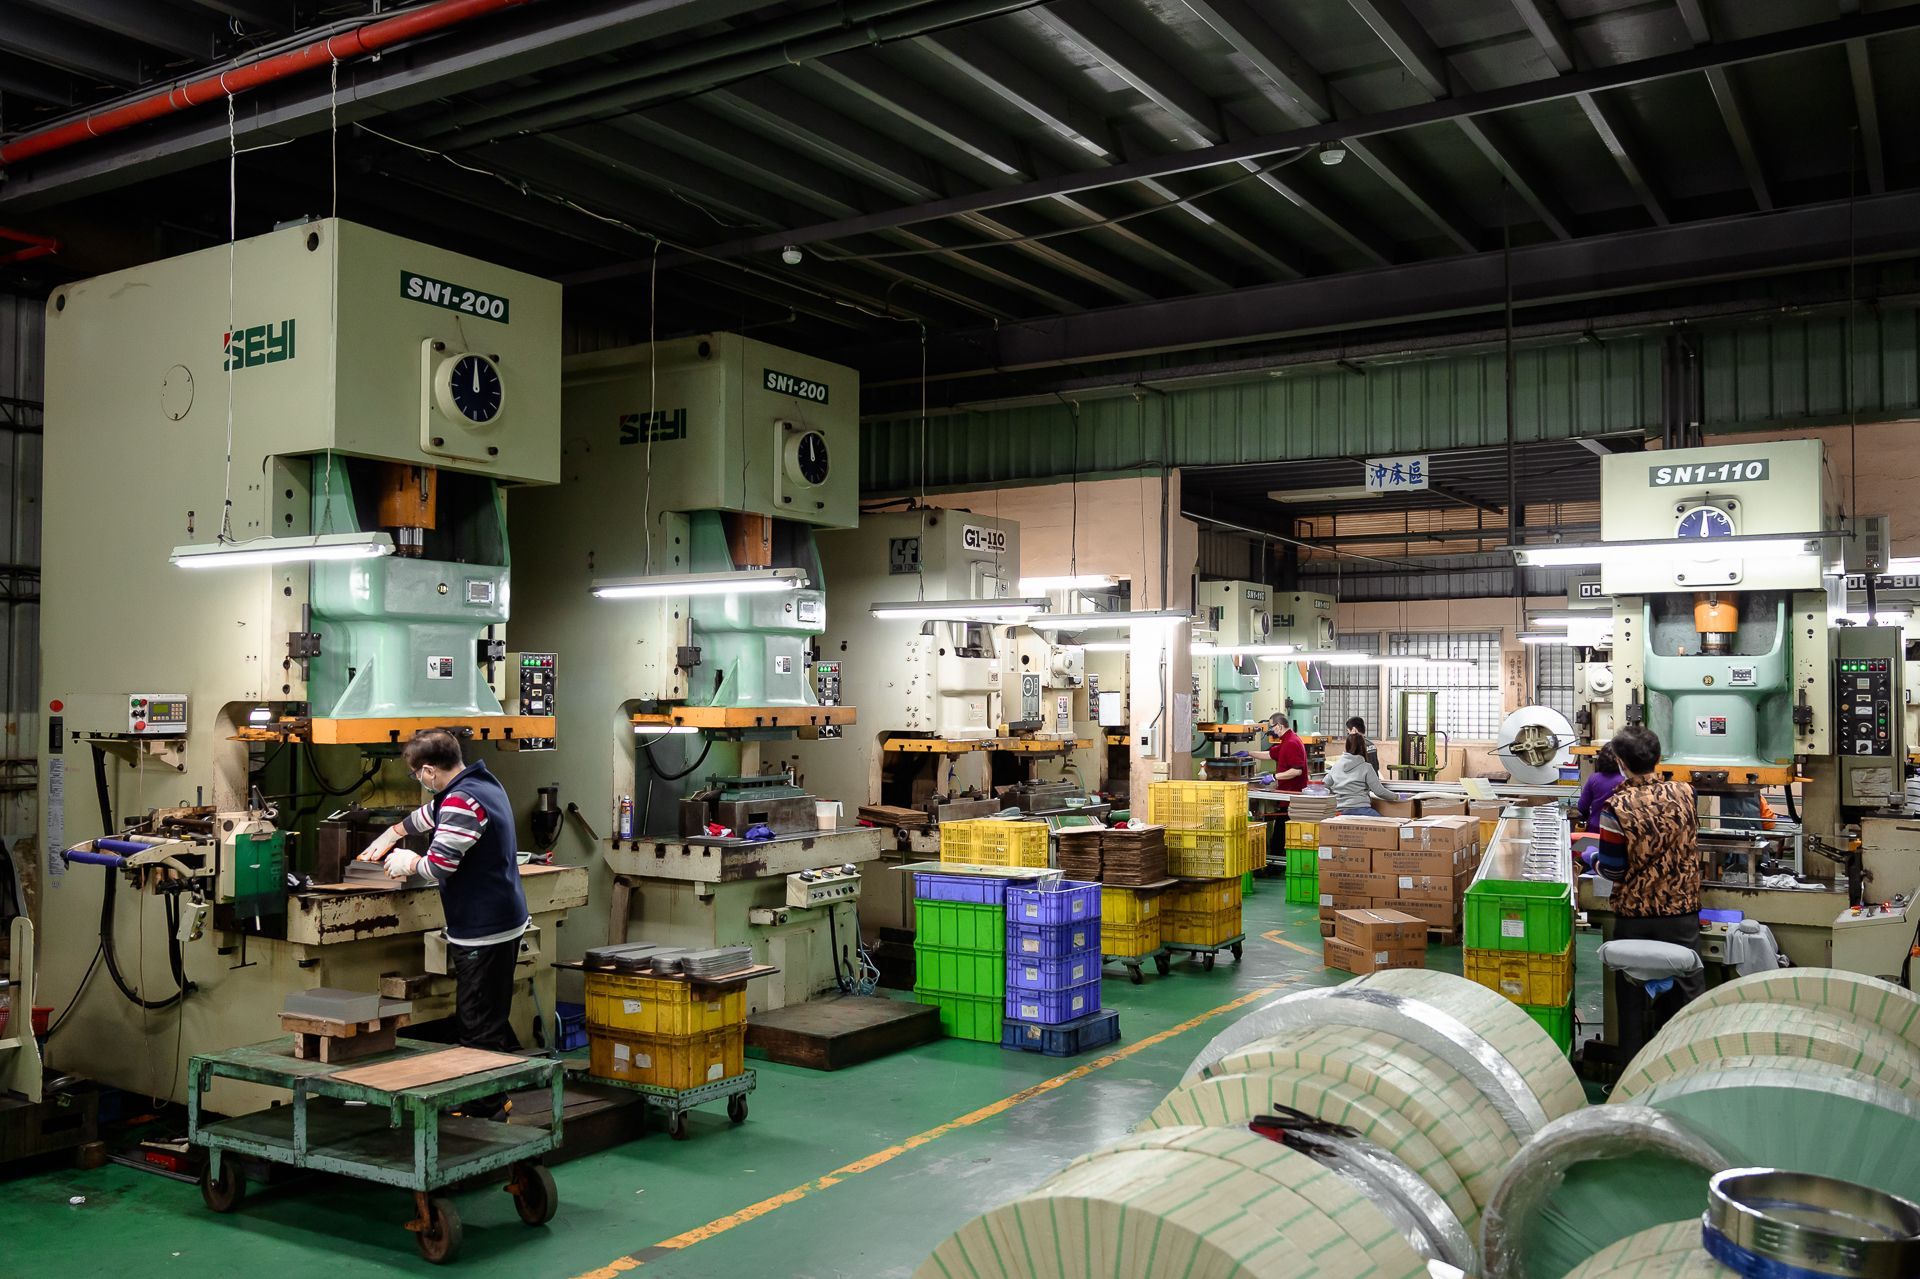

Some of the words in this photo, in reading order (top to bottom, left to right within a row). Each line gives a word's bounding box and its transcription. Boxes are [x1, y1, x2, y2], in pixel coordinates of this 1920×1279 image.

[407, 277, 504, 319] SN1-200
[223, 318, 296, 372] SEYI
[767, 373, 826, 401] SN1-200
[619, 408, 687, 445] SEYI
[1655, 461, 1763, 485] SN1-110
[965, 528, 1005, 547] G1-110
[1847, 575, 1920, 589] OCP-80
[1273, 614, 1295, 627] EYI
